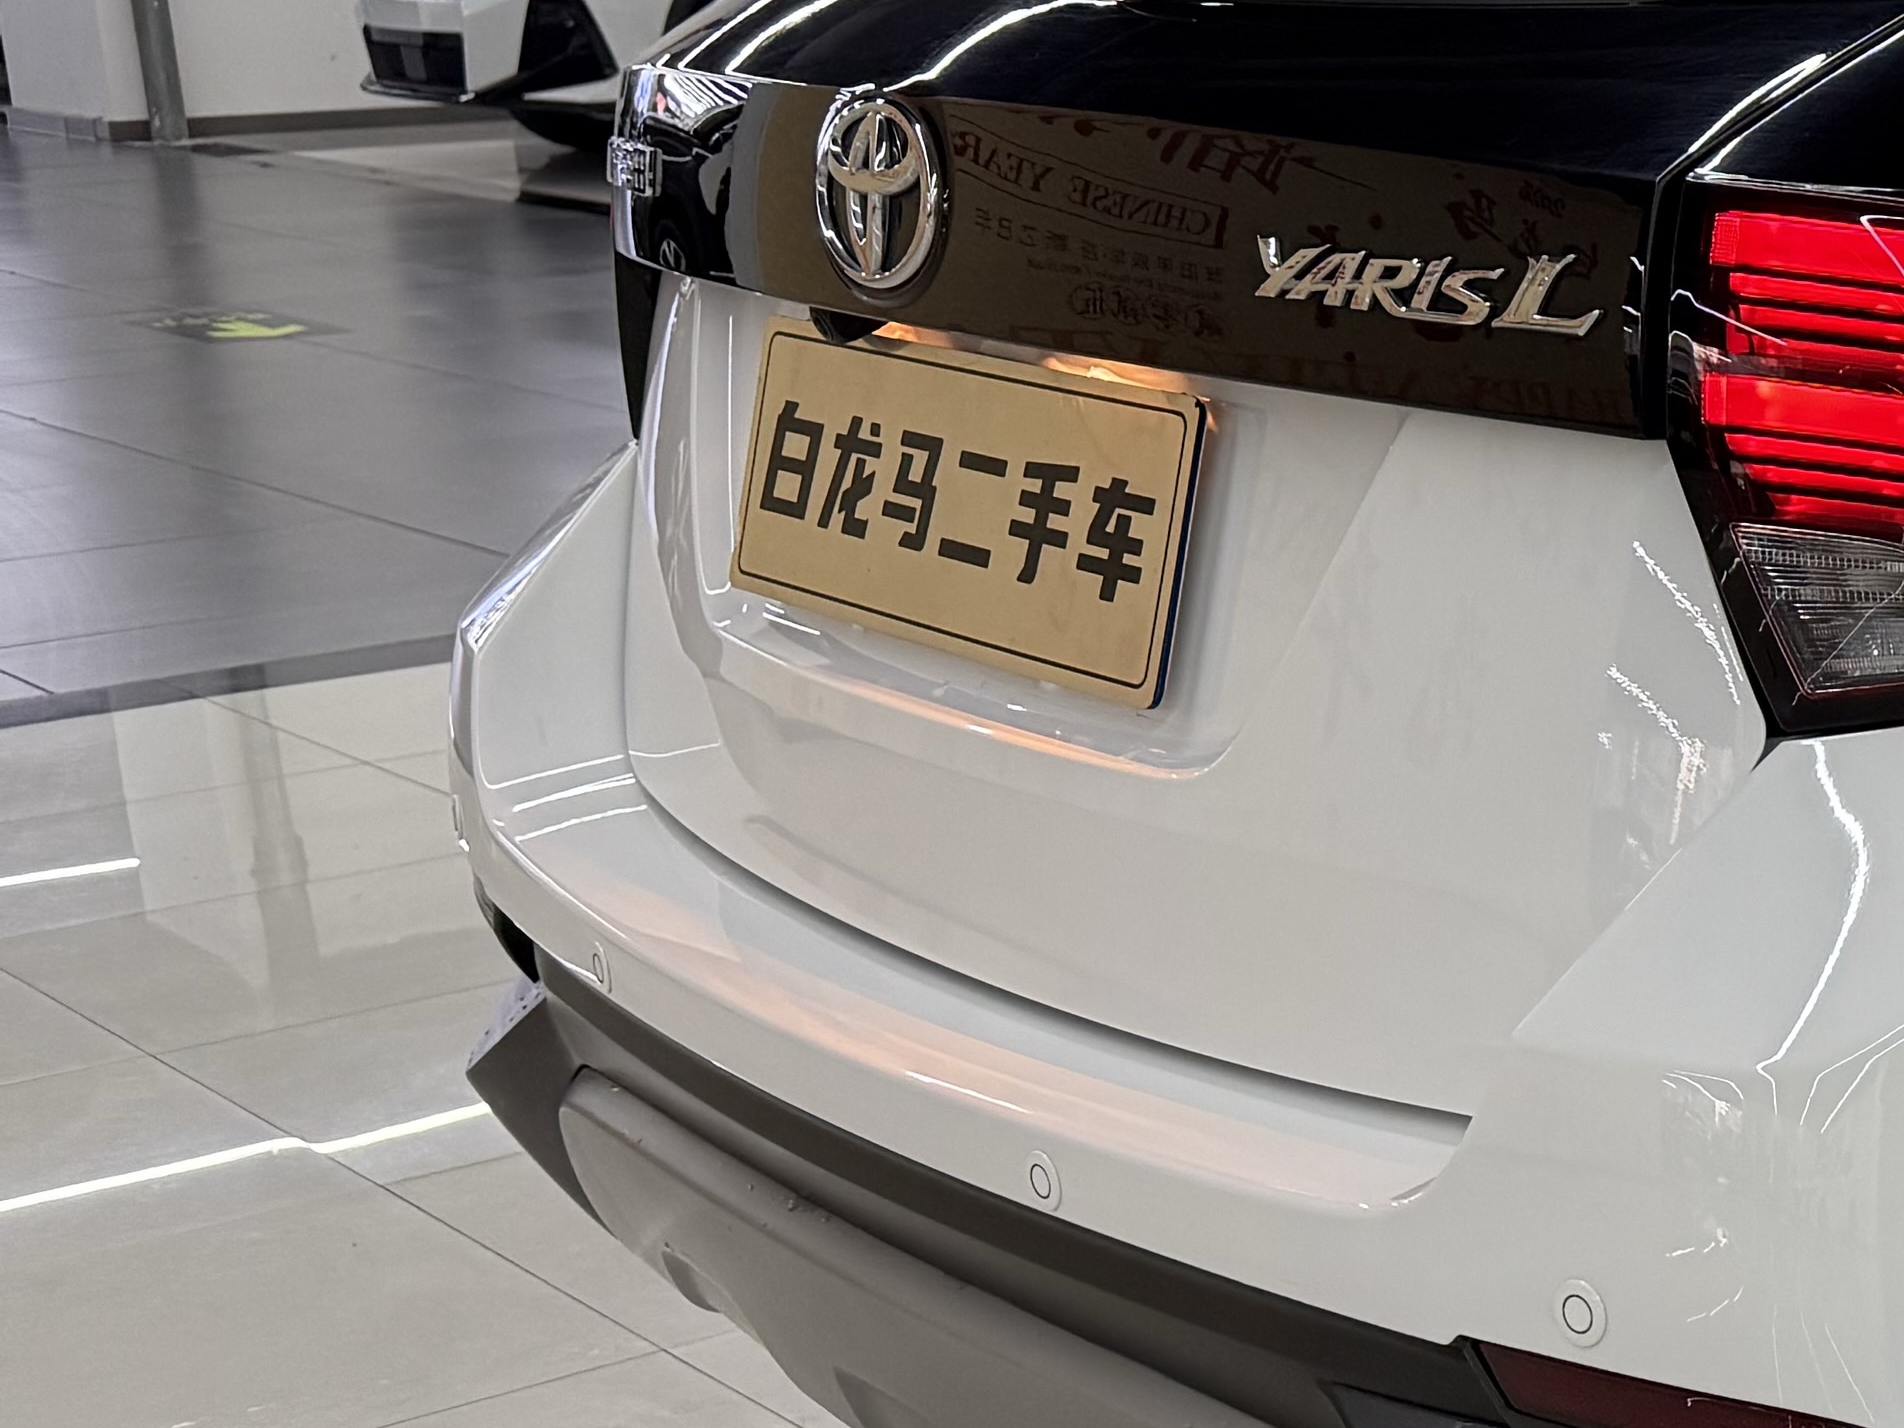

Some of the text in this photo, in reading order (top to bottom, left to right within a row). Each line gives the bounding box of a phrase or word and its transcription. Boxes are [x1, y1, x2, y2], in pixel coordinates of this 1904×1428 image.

[1256, 235, 1504, 326] YARIS
[1490, 254, 1602, 335] L
[760, 401, 1156, 600] 白龙马二手车
